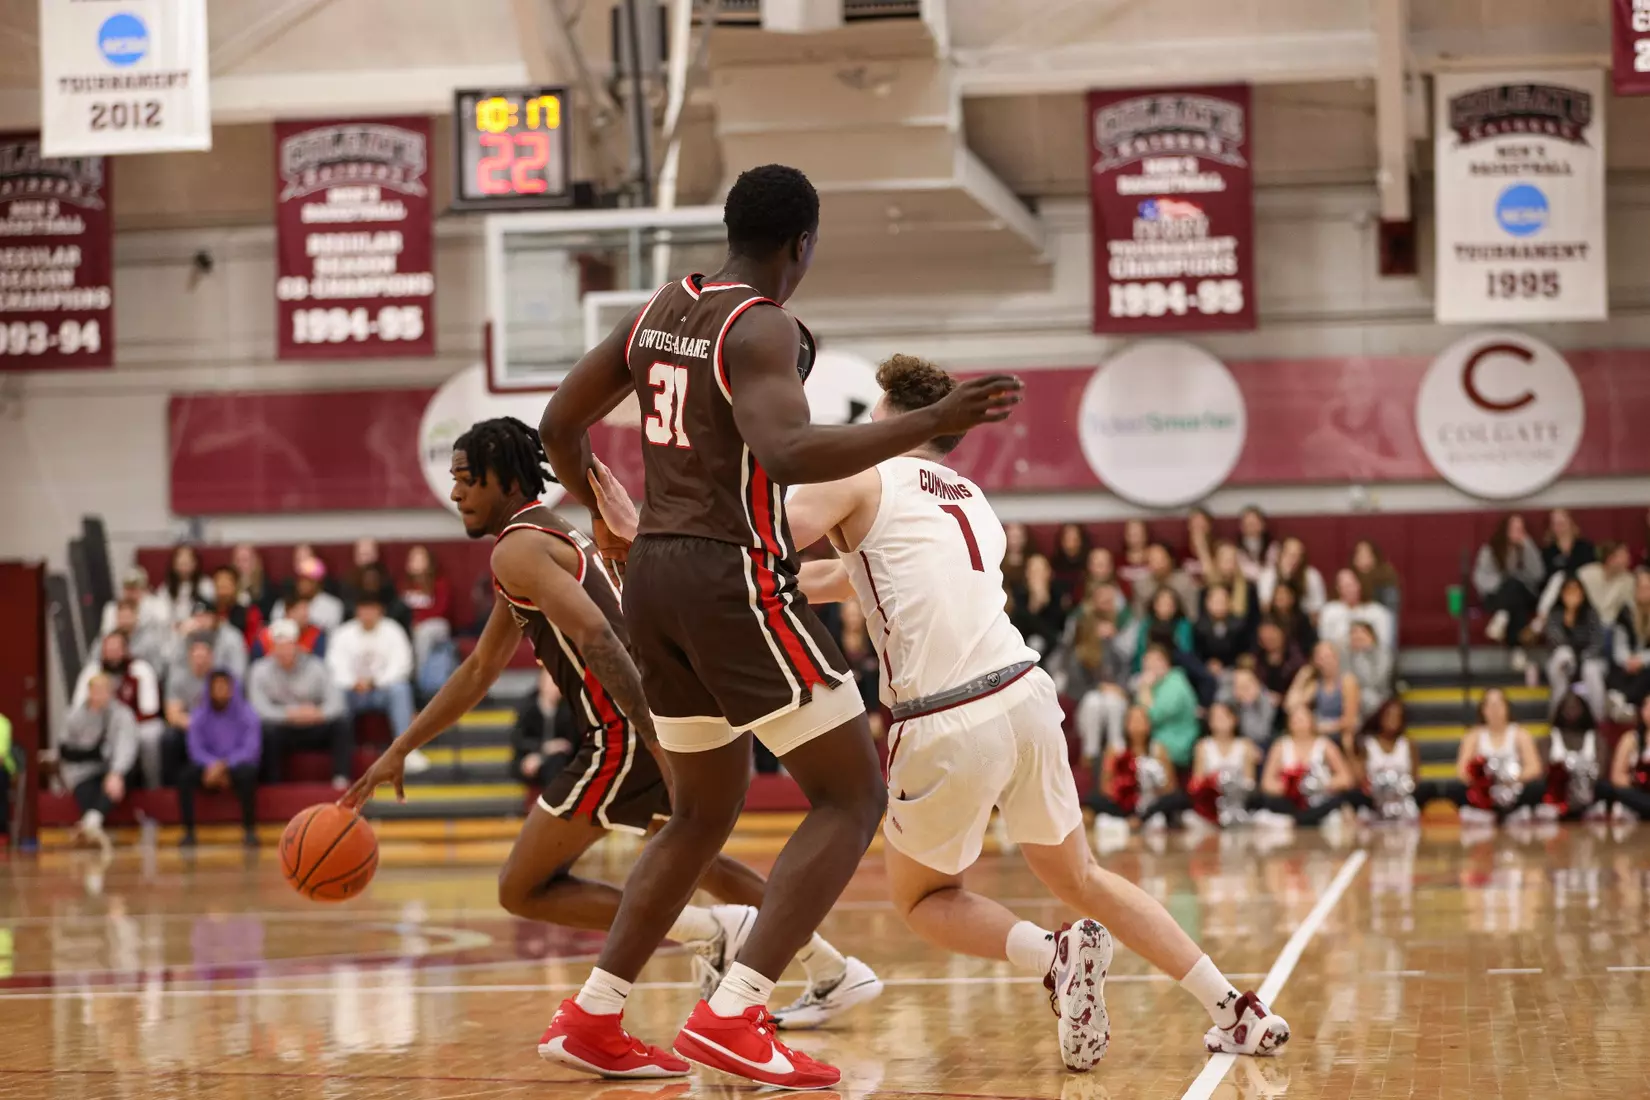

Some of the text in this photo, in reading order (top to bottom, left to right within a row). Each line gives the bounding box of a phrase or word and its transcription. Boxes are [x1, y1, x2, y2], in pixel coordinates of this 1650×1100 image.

[58, 71, 190, 93] TOURNAMENT
[90, 101, 163, 131] 2012
[477, 132, 550, 193] 22
[1495, 145, 1546, 157] MEN'S
[1469, 162, 1573, 177] BASKETBALL
[306, 231, 403, 257] REGULAR
[1455, 243, 1590, 261] TOURNAMENT
[313, 255, 397, 277] SEASON
[1108, 254, 1237, 280] CHAMPIONS
[1109, 280, 1243, 317] 1994-95
[1486, 270, 1561, 298] 1995
[0, 320, 101, 354] 93-94
[292, 306, 424, 343] 1994-95
[1461, 342, 1537, 414] C
[645, 361, 692, 448] 31
[1437, 422, 1559, 445] COLGATE
[919, 468, 973, 500] CUMMINS
[937, 504, 985, 573] 1
